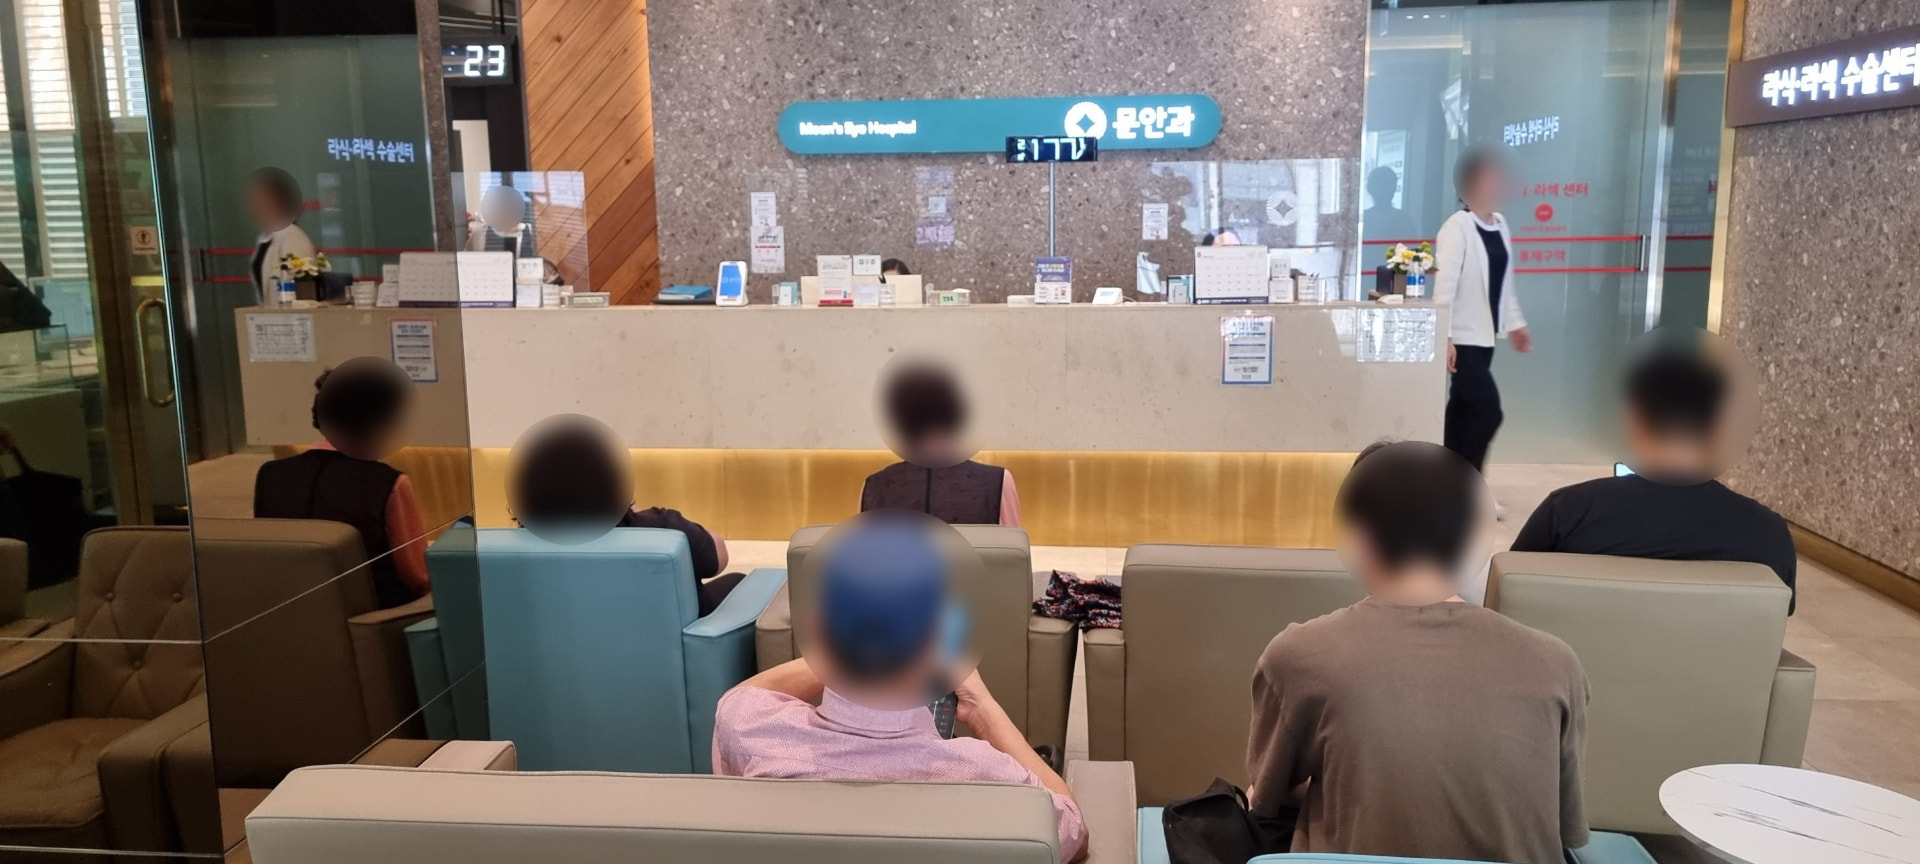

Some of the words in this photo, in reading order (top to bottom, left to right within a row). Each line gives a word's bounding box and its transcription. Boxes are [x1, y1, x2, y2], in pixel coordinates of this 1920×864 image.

[464, 45, 505, 76] 23
[1841, 43, 1920, 96] 수술센터
[799, 121, 844, 136] Moon's
[844, 121, 867, 138] Eye
[868, 119, 917, 138] Hospital
[1112, 105, 1196, 140] 문안과
